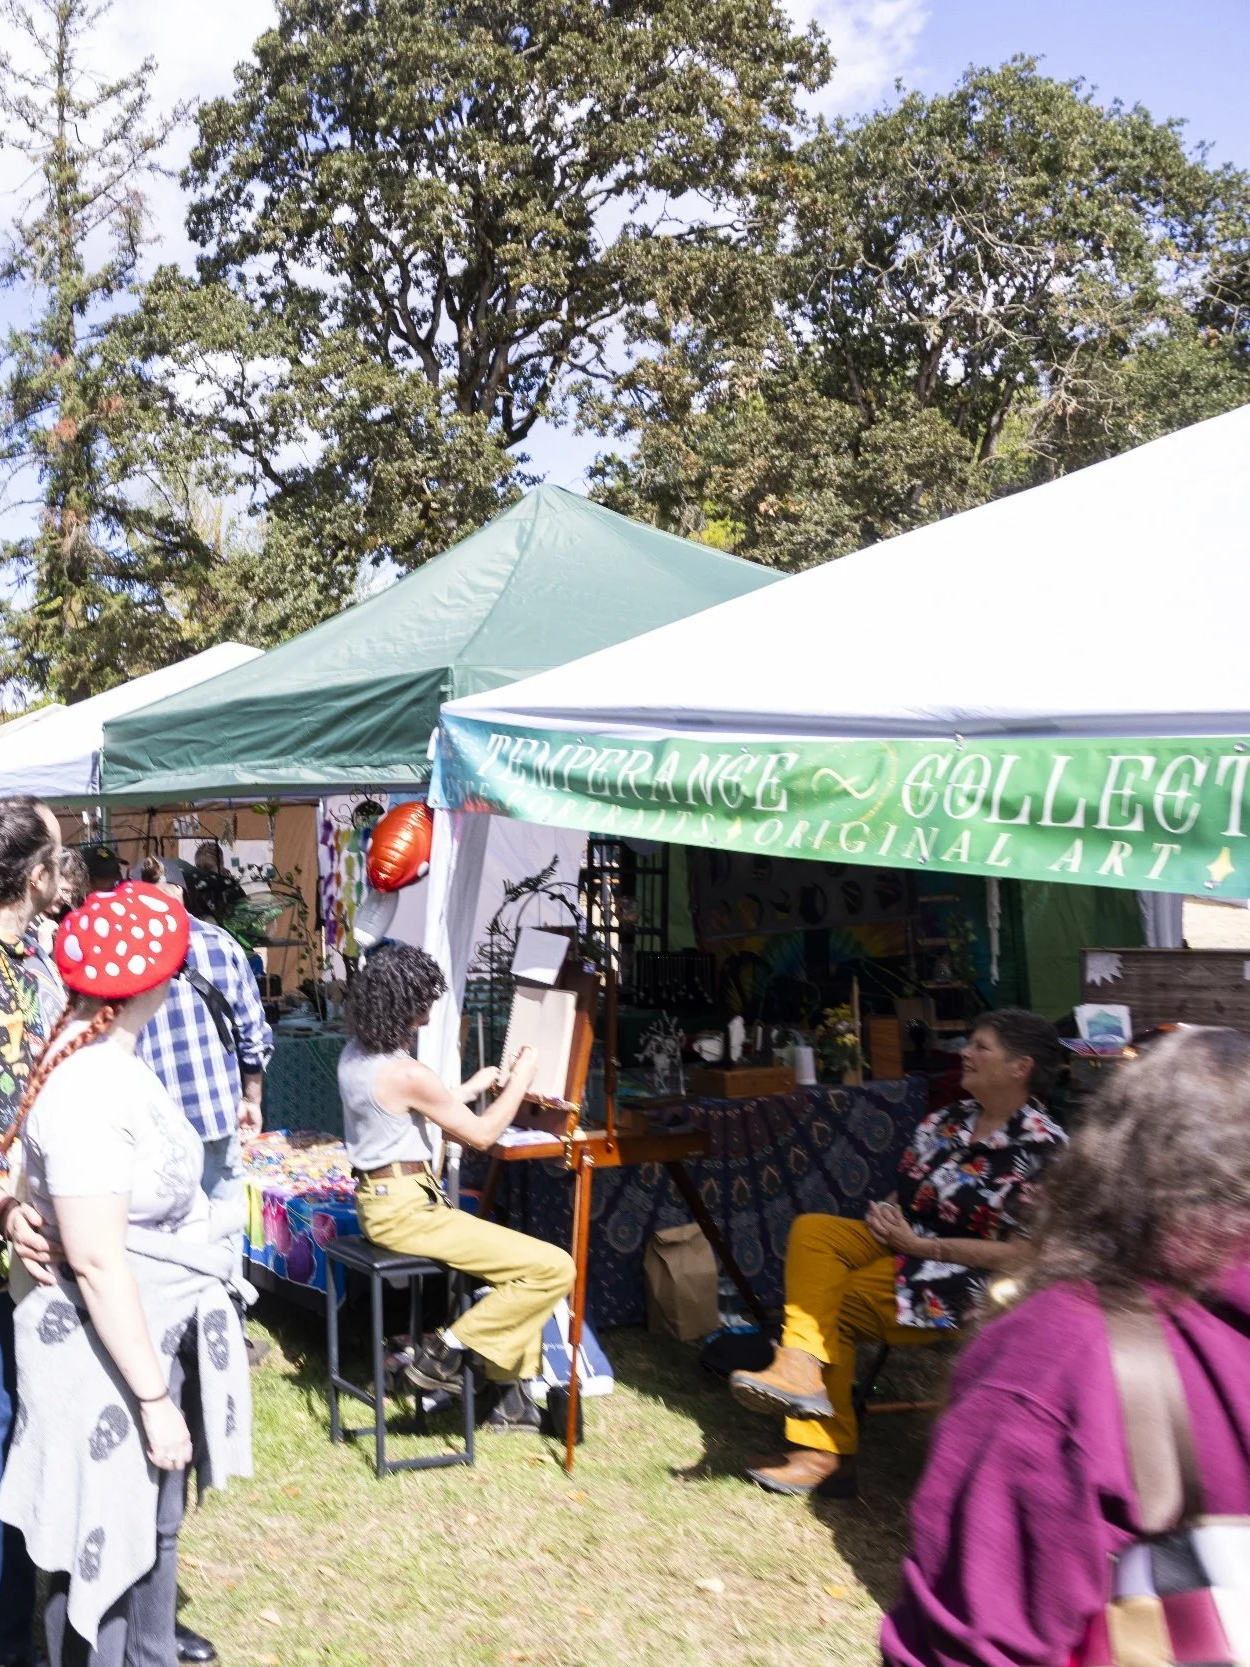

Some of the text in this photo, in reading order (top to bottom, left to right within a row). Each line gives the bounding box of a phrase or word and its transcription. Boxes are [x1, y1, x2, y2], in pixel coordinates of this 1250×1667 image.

[476, 733, 1250, 837] TEMPERANCE COLLECT
[506, 788, 716, 839] PORTRAITS
[753, 818, 1012, 867] ORIGINAL
[1046, 838, 1182, 880] ART
